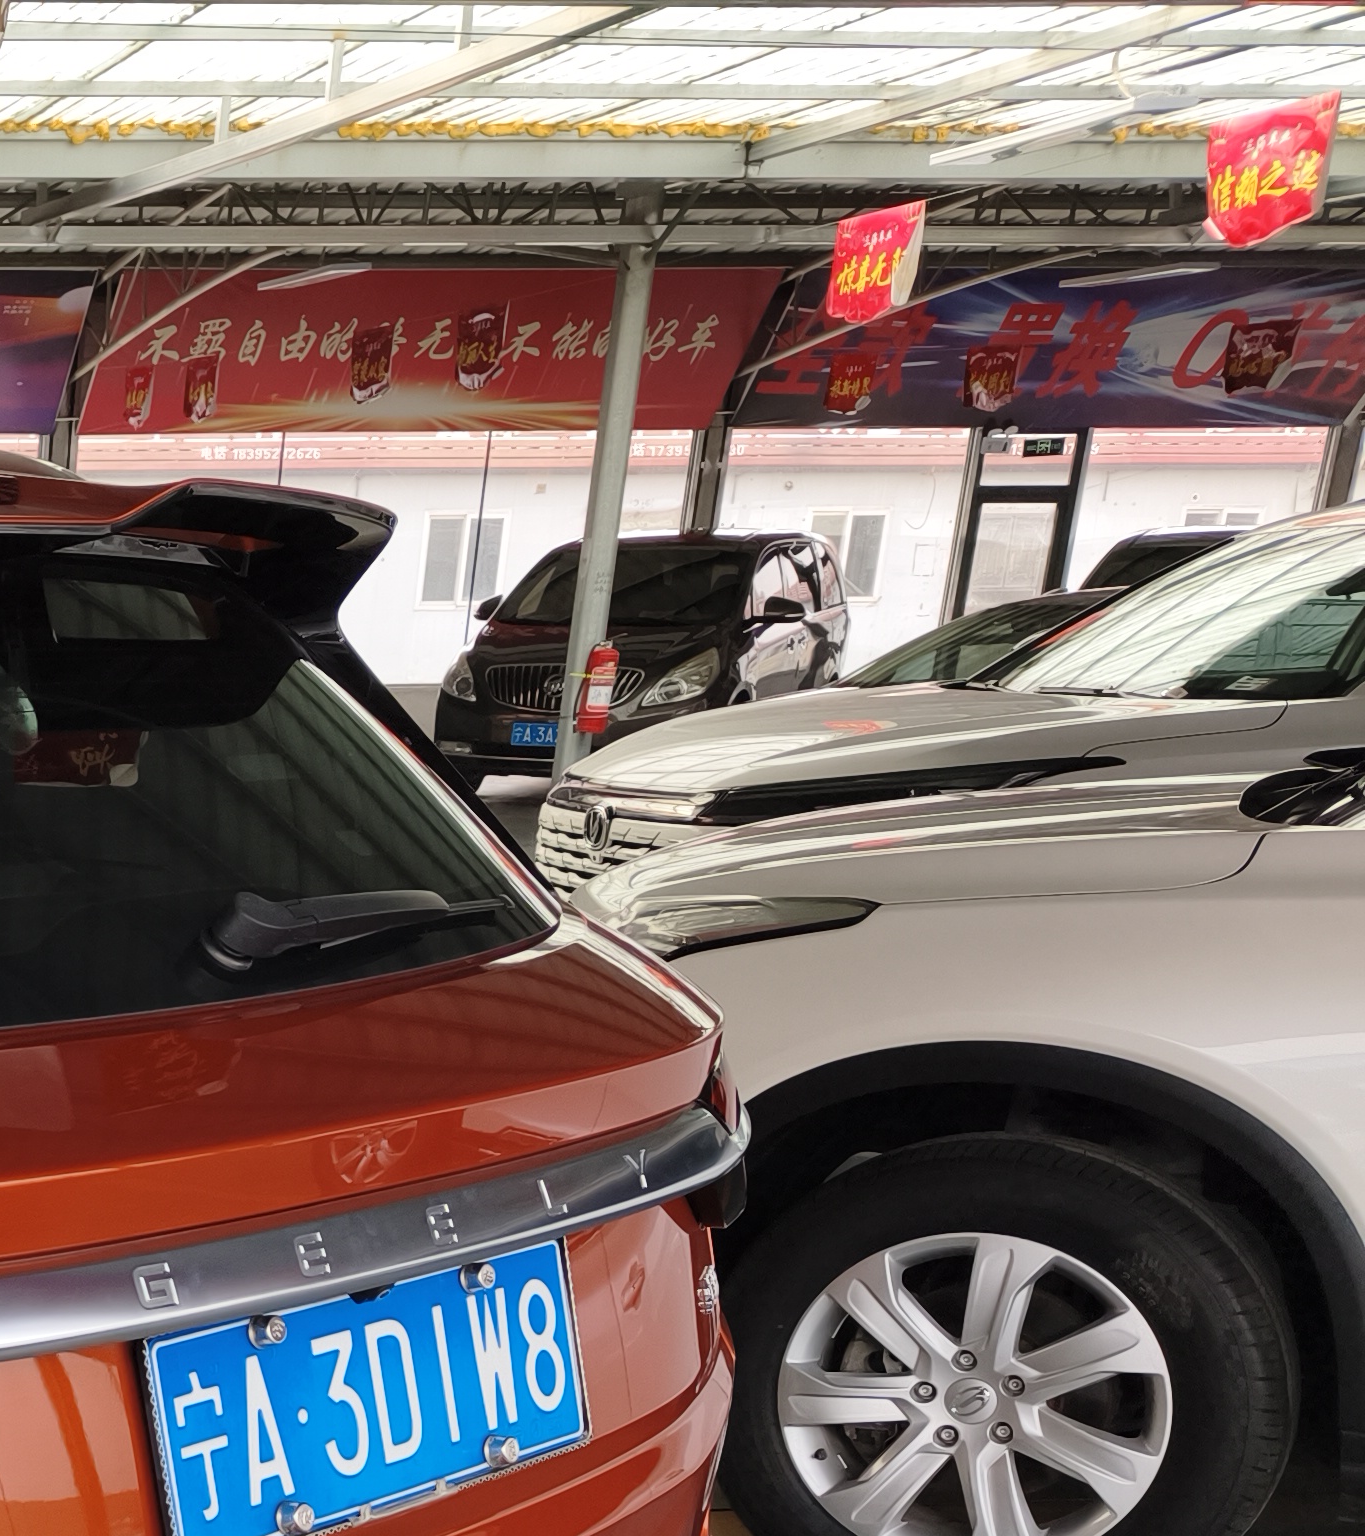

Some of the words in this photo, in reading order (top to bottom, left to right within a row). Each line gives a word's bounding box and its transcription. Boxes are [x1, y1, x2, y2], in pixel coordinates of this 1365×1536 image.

[1212, 150, 1322, 214] 信赖之选
[132, 1148, 648, 1310] GEELY
